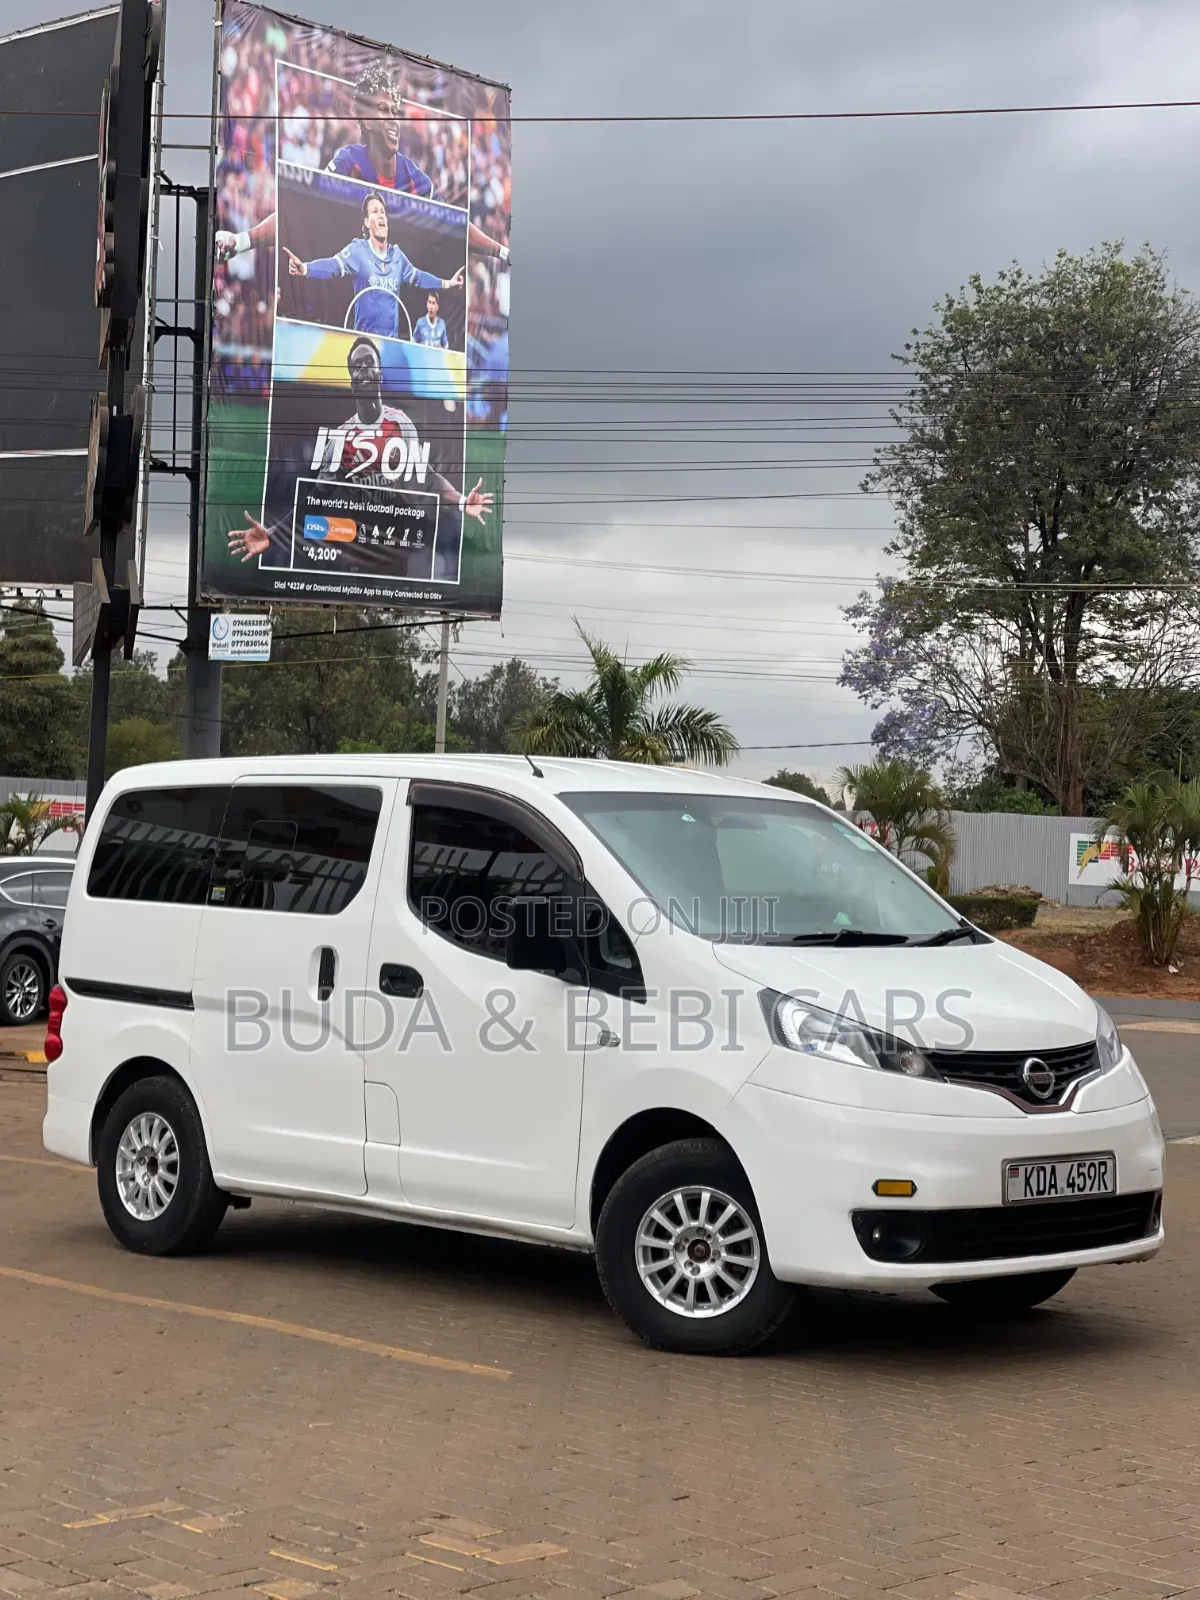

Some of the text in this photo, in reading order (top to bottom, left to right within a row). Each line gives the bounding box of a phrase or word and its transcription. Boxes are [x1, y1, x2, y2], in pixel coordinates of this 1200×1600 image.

[310, 427, 430, 484] IT'S ON
[306, 496, 425, 519] The world's best football package
[306, 524, 326, 532] DStv
[274, 581, 286, 590] Dial
[313, 584, 341, 592] Download
[342, 586, 363, 595] MyDStv
[363, 588, 374, 597] App
[376, 588, 381, 596] to
[382, 589, 394, 598] stay
[394, 590, 422, 599] Connected
[430, 592, 442, 600] DStv
[1024, 1160, 1108, 1198] KDA 459R
